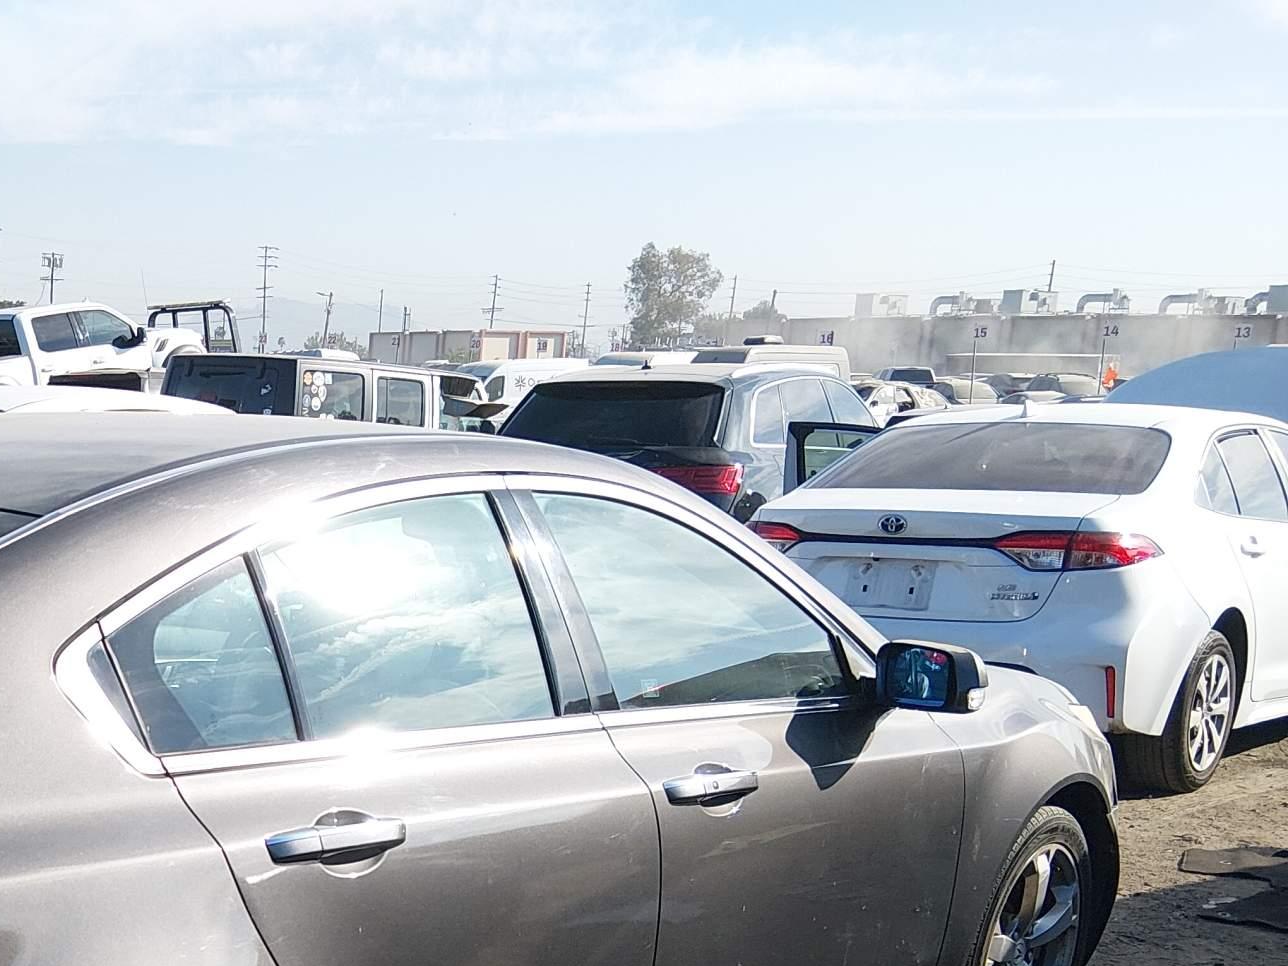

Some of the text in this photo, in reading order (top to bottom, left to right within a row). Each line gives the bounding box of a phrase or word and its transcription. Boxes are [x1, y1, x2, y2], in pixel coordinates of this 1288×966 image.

[974, 327, 988, 338] 15
[1103, 325, 1119, 337] 14
[1234, 326, 1251, 338] 13
[328, 336, 337, 344] 22
[471, 339, 481, 348] 20
